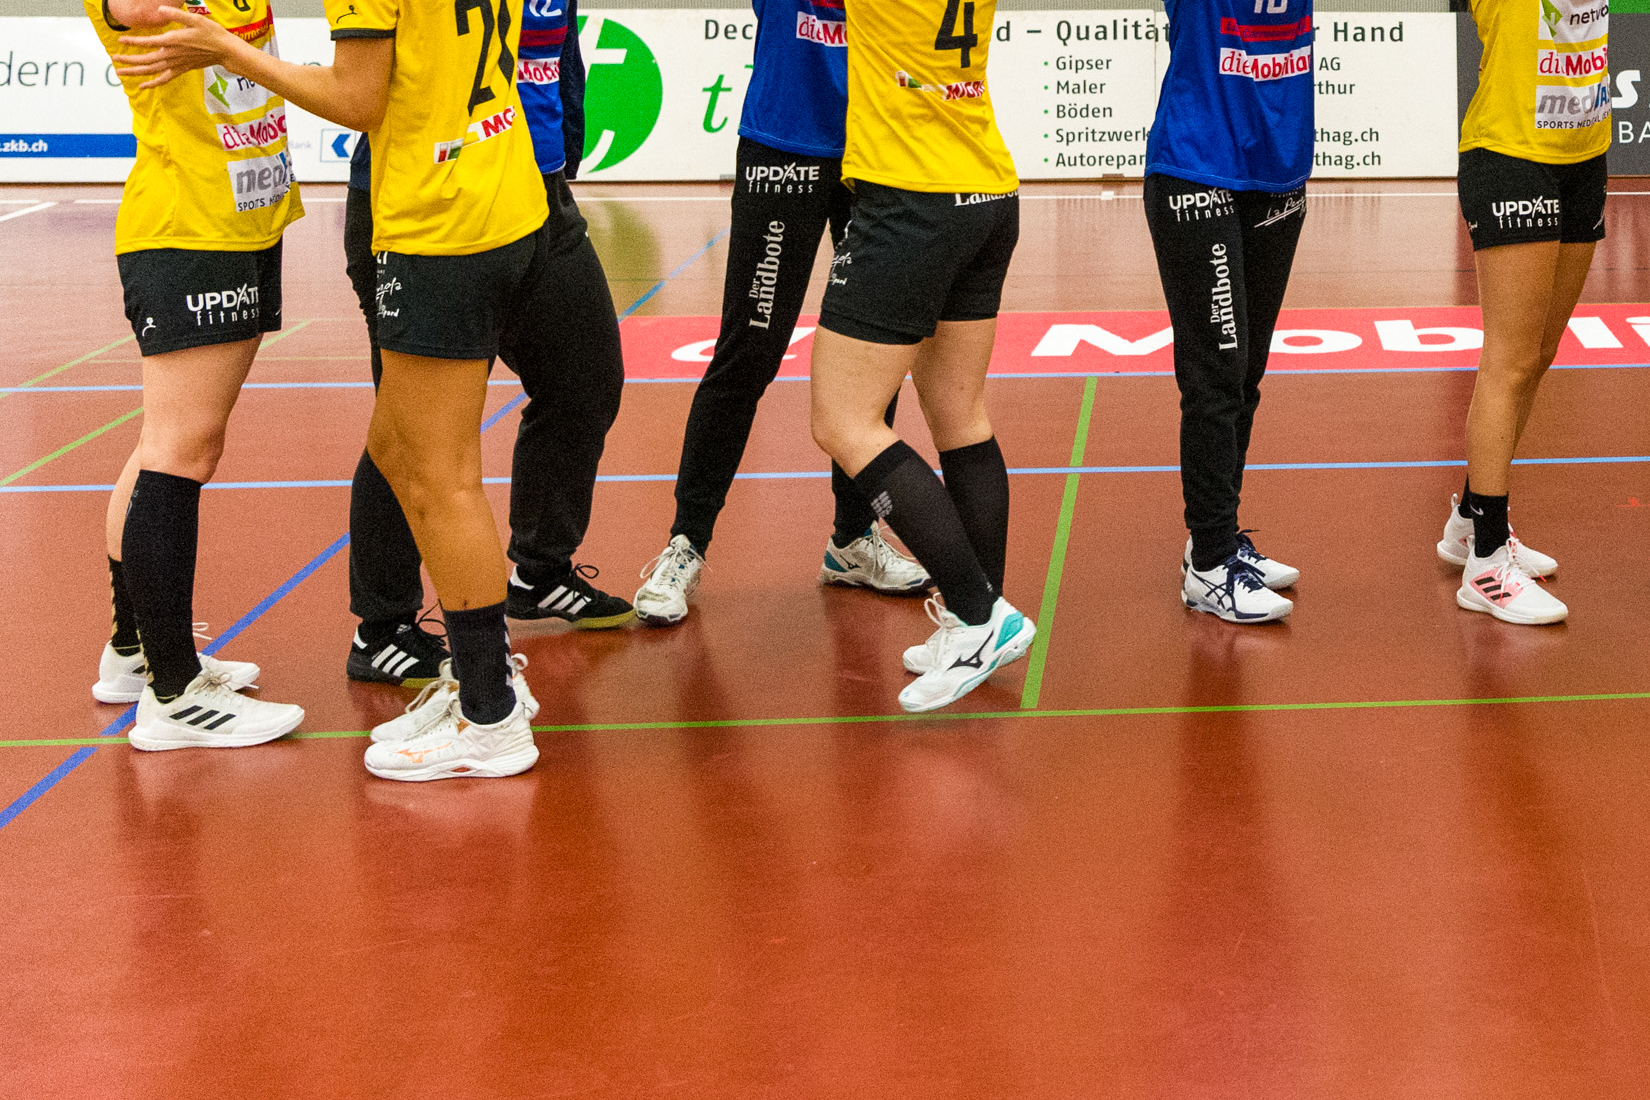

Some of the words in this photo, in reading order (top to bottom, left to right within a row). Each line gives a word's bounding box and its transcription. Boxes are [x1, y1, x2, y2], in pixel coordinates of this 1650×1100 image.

[705, 19, 754, 41] Dec
[1333, 21, 1404, 43] Hand
[1055, 55, 1112, 74] Gipser
[1319, 56, 1341, 71] AG
[1055, 79, 1106, 95] Maler
[1055, 103, 1113, 119] Böden
[1537, 119, 1575, 129] SPORTS
[745, 162, 820, 184] UPDATE
[748, 180, 813, 193] fitness
[1169, 187, 1234, 210] UPDATE
[1492, 195, 1560, 218] UPDATE
[1176, 204, 1235, 222] fitness
[1499, 215, 1559, 230] fitness
[749, 220, 786, 331] Landbote
[749, 277, 761, 299] Der
[1209, 243, 1239, 351] Landbote
[1210, 303, 1221, 324] Der
